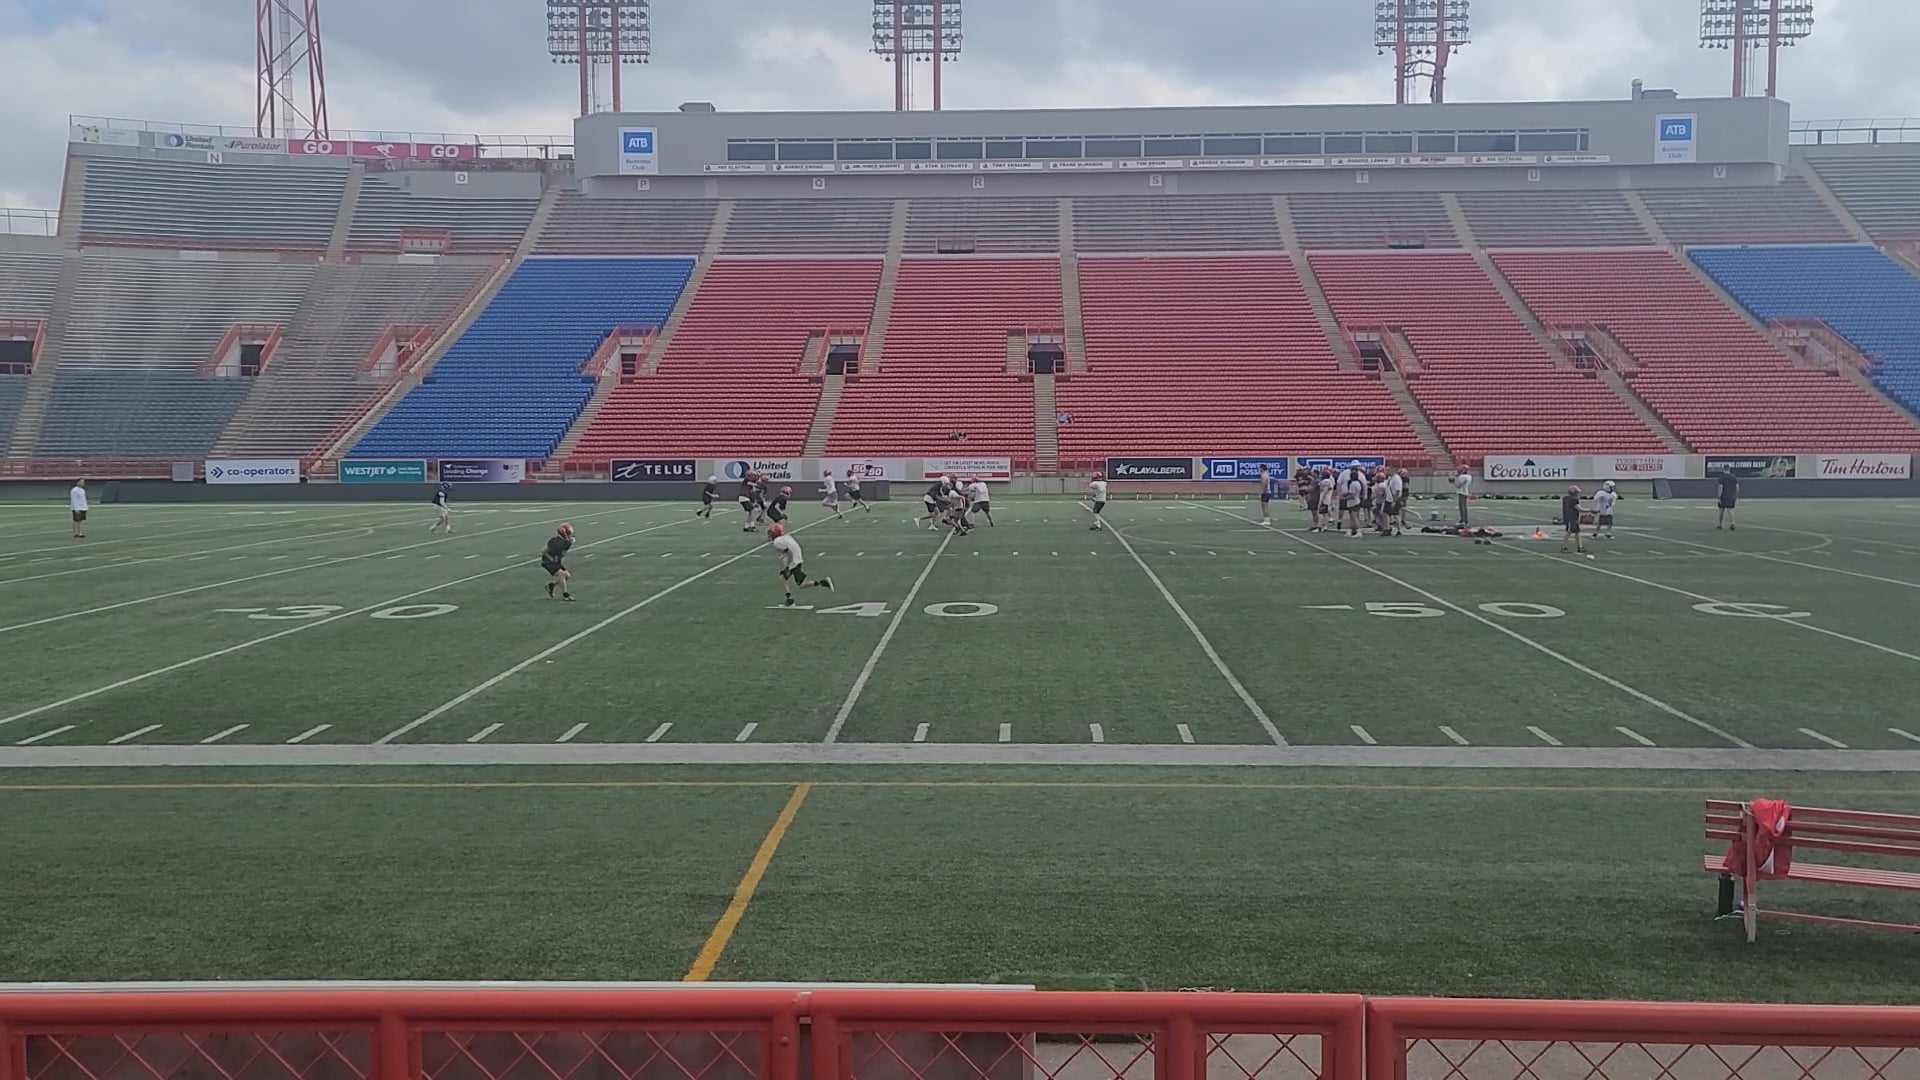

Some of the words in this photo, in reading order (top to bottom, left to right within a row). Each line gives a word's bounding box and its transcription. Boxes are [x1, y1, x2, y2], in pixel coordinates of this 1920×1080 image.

[1665, 124, 1687, 135] ATB
[185, 135, 213, 143] United
[628, 137, 648, 148] ATB
[185, 142, 215, 150] Rentals
[233, 139, 281, 151] Purolator
[303, 141, 333, 154] GO
[431, 145, 459, 158] GO
[210, 153, 220, 164] N
[1358, 172, 1366, 182] T
[1530, 170, 1538, 180] U
[1715, 167, 1724, 177] V
[457, 173, 467, 183] O
[814, 178, 824, 188] Q
[974, 177, 983, 186] R
[1152, 176, 1160, 185] S
[640, 179, 648, 189] P
[644, 464, 693, 475] TELUS
[753, 461, 788, 470] United
[1215, 464, 1233, 473] ATB
[1490, 463, 1529, 478] Coors
[1532, 467, 1568, 477] LIGHT
[1822, 459, 1847, 474] Tim
[1850, 458, 1905, 475] Hortons
[227, 467, 295, 477] co-operators
[344, 466, 386, 477] WESTJET
